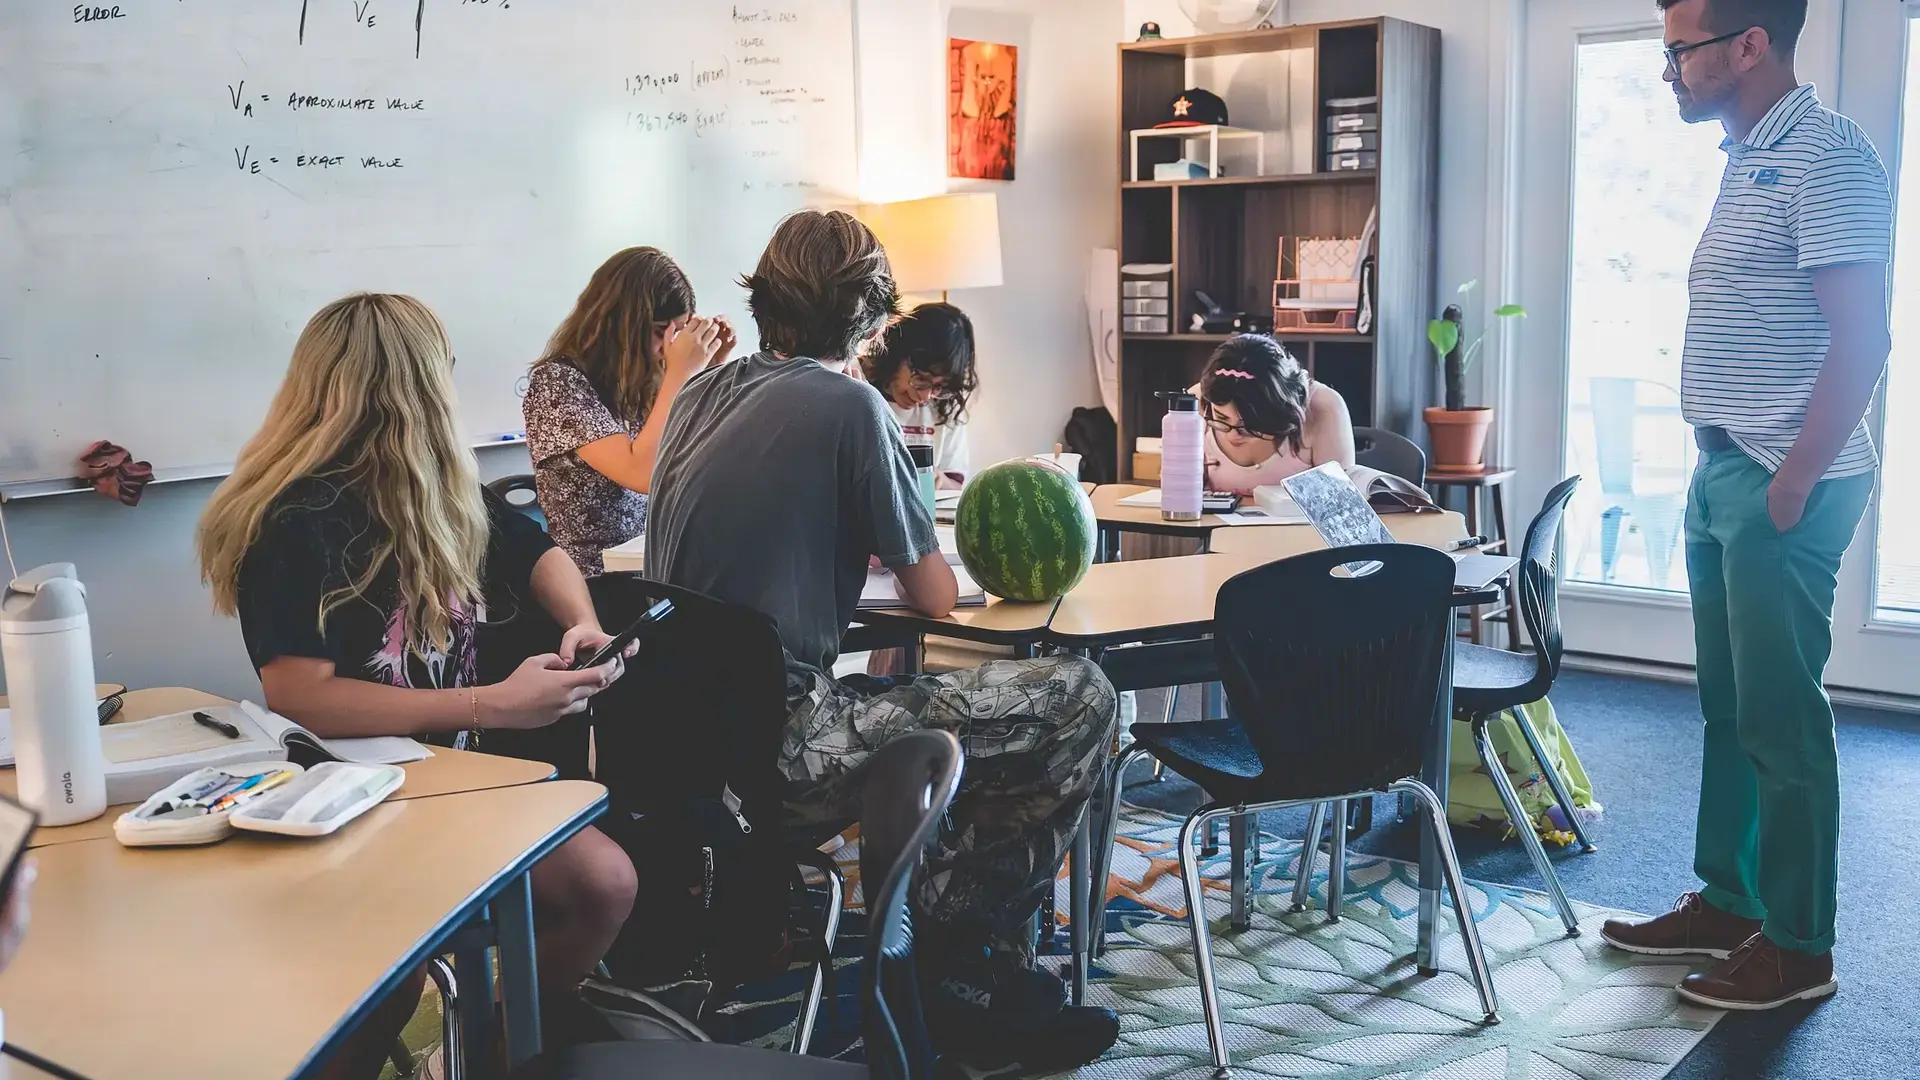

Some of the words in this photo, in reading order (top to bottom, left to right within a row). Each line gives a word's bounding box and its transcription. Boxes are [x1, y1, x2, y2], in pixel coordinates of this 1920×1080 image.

[73, 4, 126, 23] ERROR
[287, 92, 376, 111] APPROXIMATE
[387, 97, 425, 111] VALUE
[296, 155, 345, 169] EXACT
[360, 156, 404, 169] VALUE
[61, 771, 74, 804] owala
[941, 977, 991, 1009] HOKA
